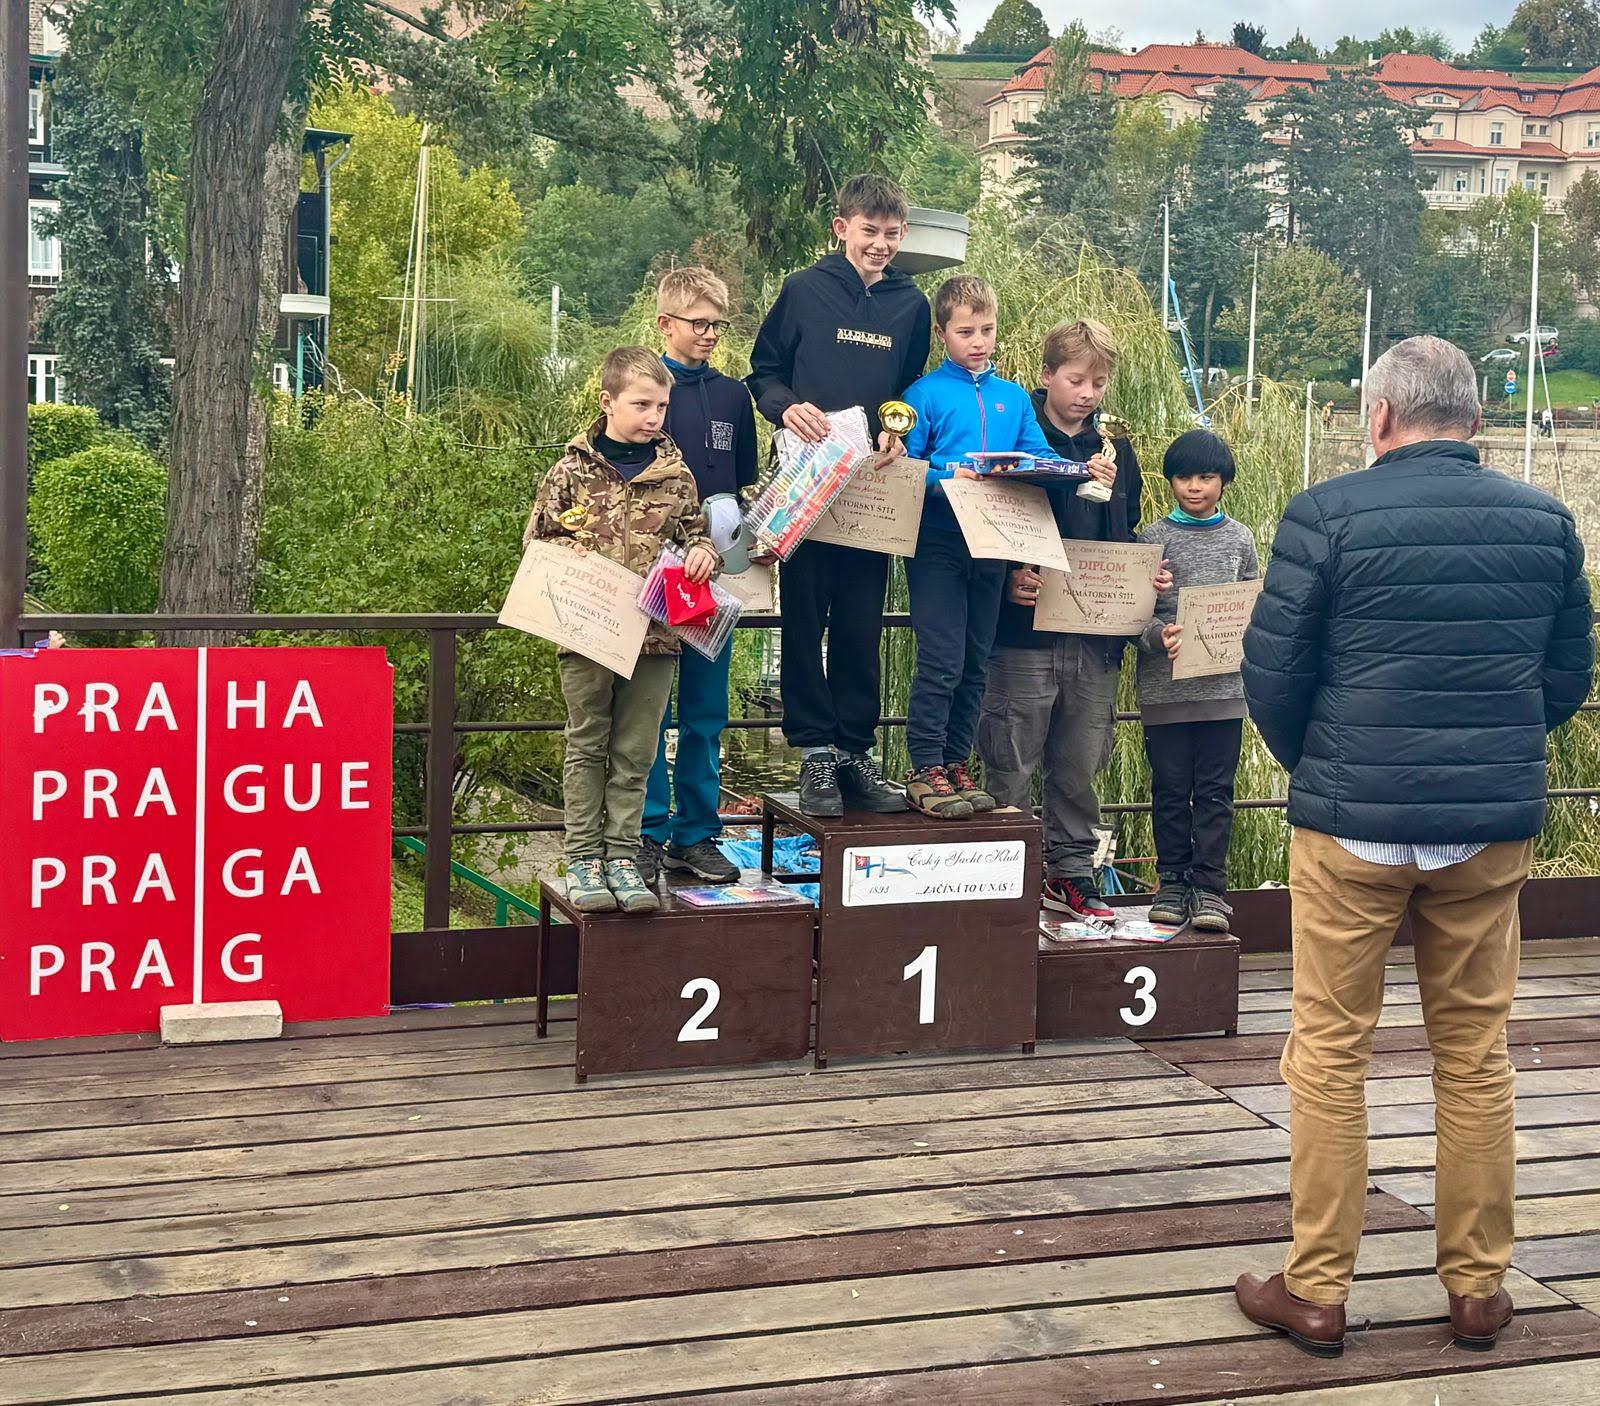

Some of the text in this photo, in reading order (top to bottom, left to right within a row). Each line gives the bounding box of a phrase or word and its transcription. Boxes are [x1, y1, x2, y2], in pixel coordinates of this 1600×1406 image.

[984, 493, 1026, 508] DIPLOM
[564, 566, 618, 597] DIPLOM
[1078, 560, 1127, 572] DIPLOM
[1207, 601, 1245, 614] DIPLOM
[34, 680, 324, 733] PRA HA
[32, 761, 371, 821] PRA GUE
[31, 847, 322, 908] PRA GA
[907, 848, 1020, 871] Český Yacht Klub
[868, 885, 890, 895] 1893
[964, 883, 977, 893] TO
[979, 883, 987, 892] U
[30, 933, 263, 996] PRA G
[903, 945, 938, 1025] 1
[676, 977, 721, 1042] 2
[1119, 966, 1158, 1026] 3
